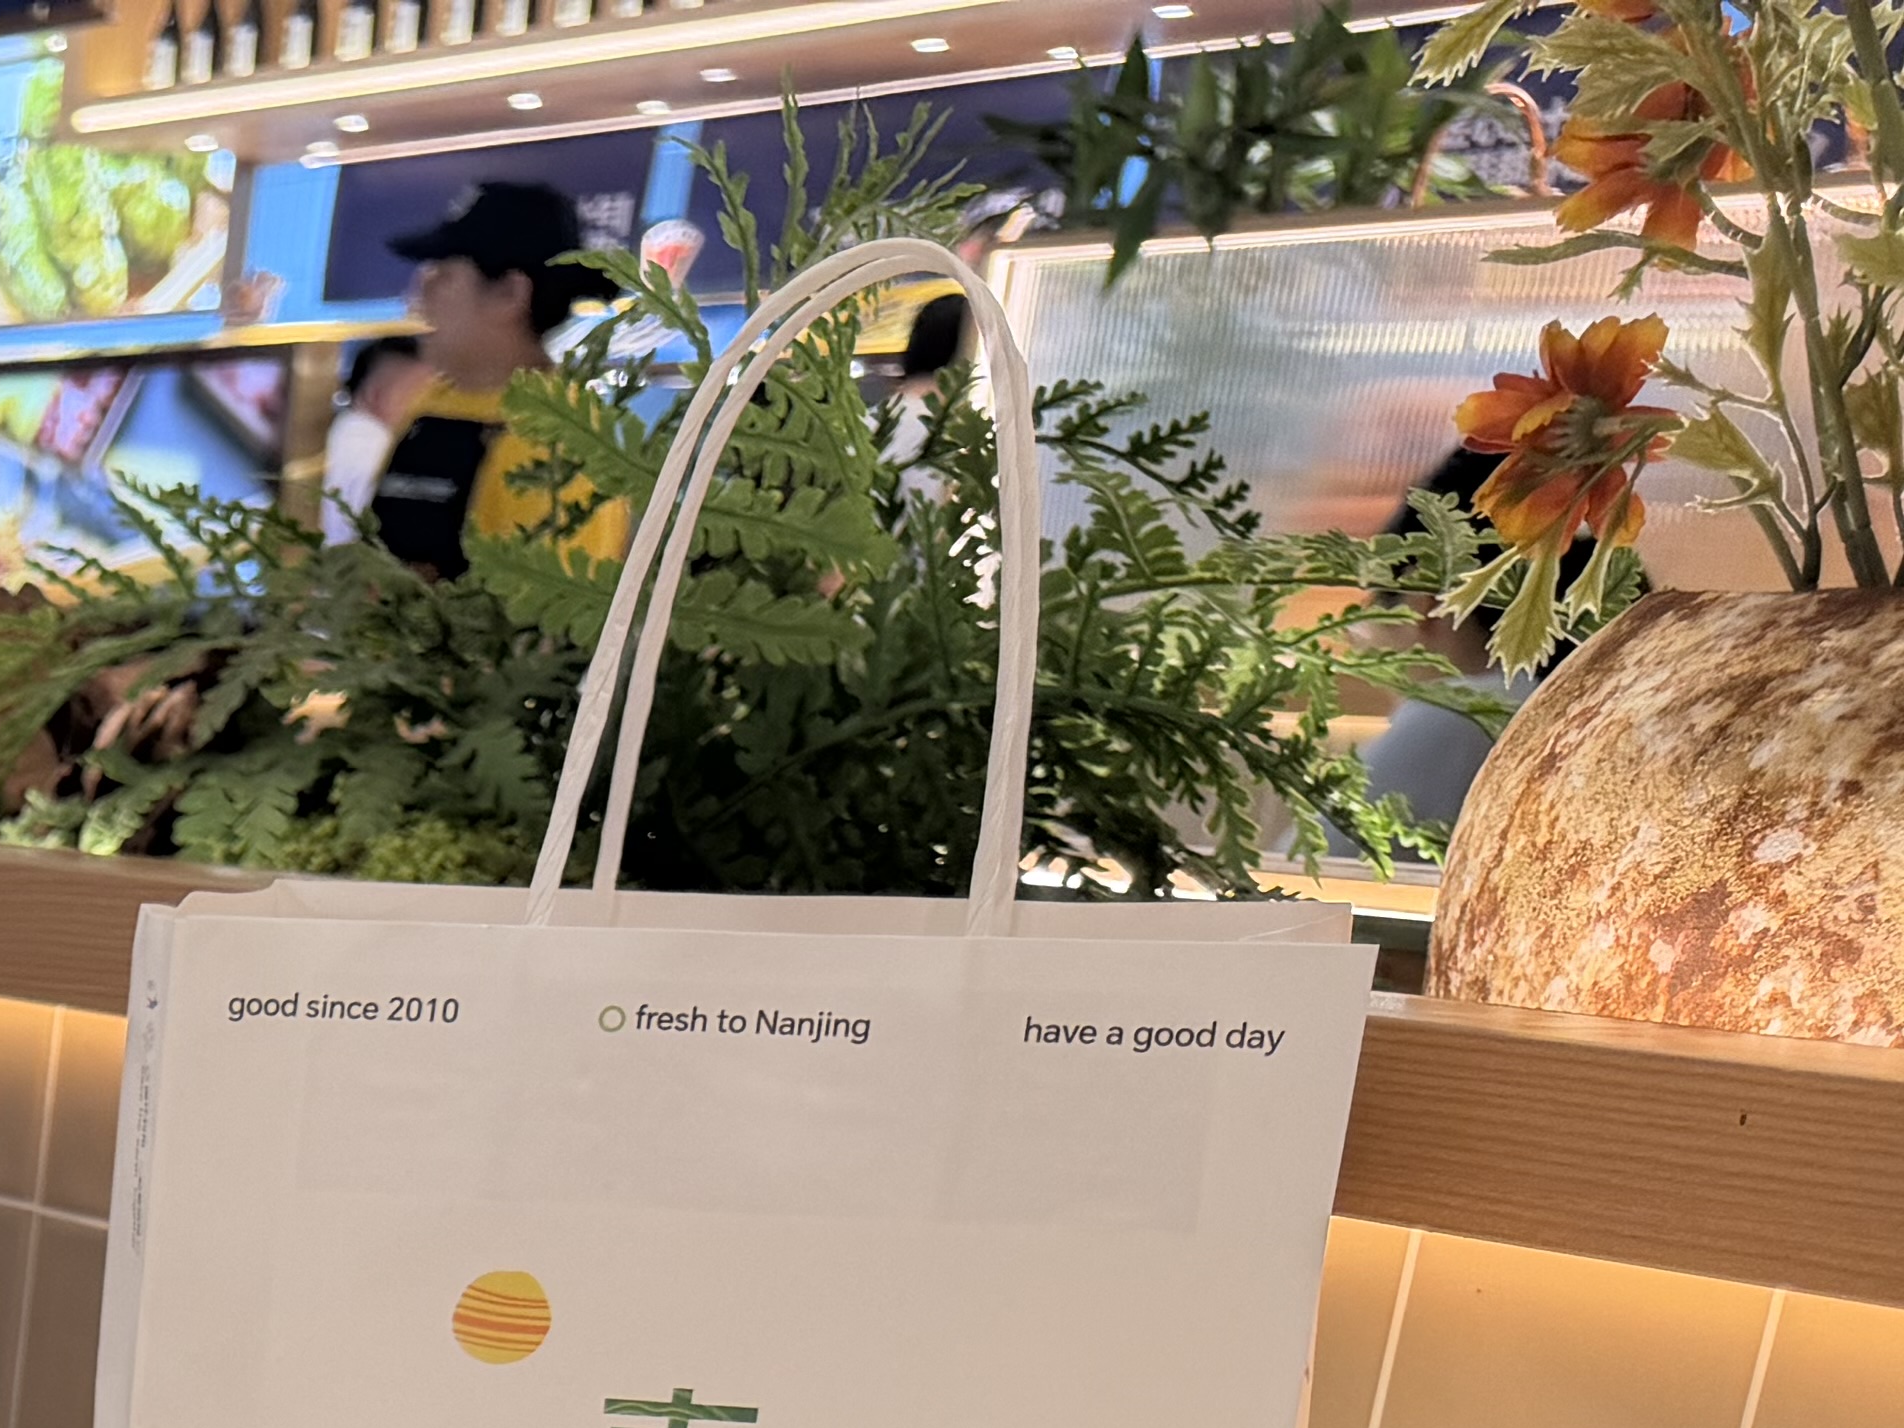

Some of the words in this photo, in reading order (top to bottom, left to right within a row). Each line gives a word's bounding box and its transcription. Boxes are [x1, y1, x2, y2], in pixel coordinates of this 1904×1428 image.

[228, 992, 299, 1022] good
[306, 995, 380, 1021] since
[388, 996, 460, 1024] 2010
[635, 1004, 708, 1033] fresh
[716, 1009, 747, 1034] to
[755, 1008, 872, 1045] Nanjing
[1023, 1016, 1098, 1045] have
[1105, 1026, 1124, 1046] a
[1132, 1021, 1217, 1053] good
[1224, 1022, 1287, 1057] day
